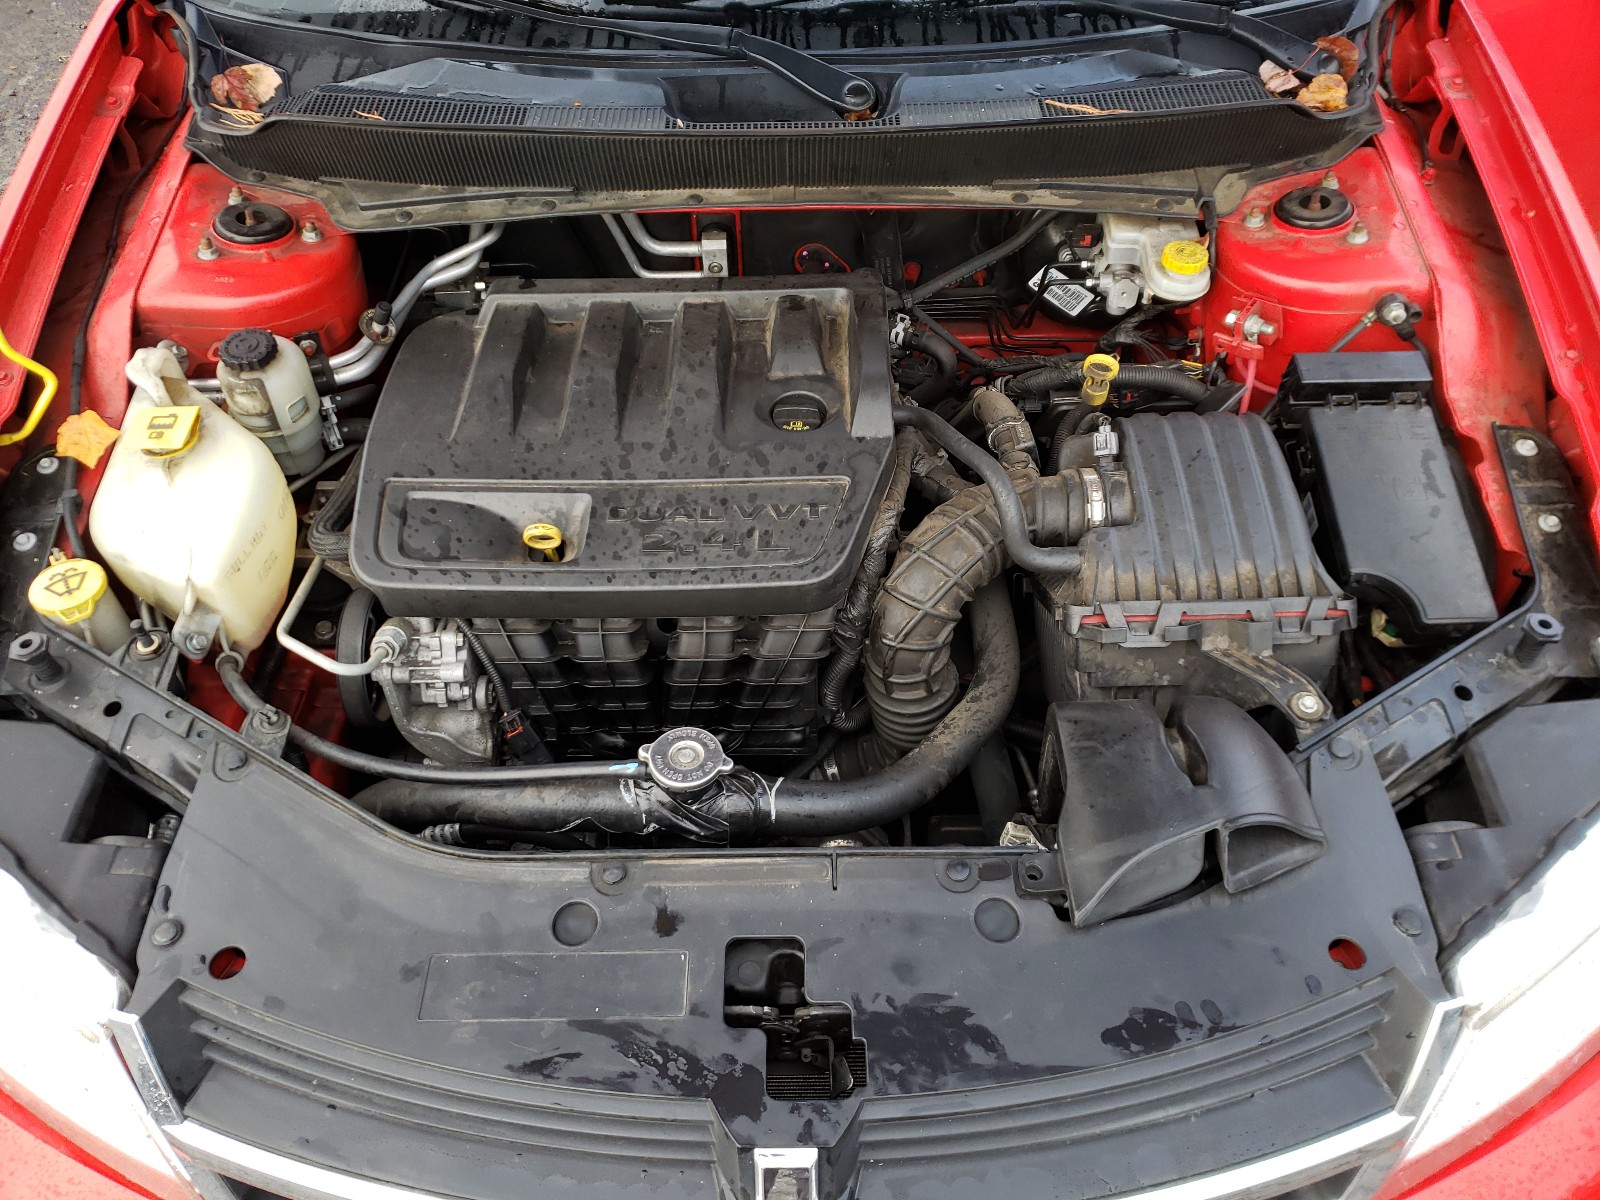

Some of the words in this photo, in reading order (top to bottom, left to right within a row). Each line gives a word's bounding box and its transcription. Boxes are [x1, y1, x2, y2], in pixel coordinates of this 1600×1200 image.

[607, 503, 726, 523] DUAL
[734, 503, 828, 521] VVT
[642, 529, 791, 553] 2.4L
[667, 730, 697, 742] SLOWLY
[704, 761, 714, 772] DO
[662, 767, 684, 781] OPEN
[687, 770, 703, 781] NOT
